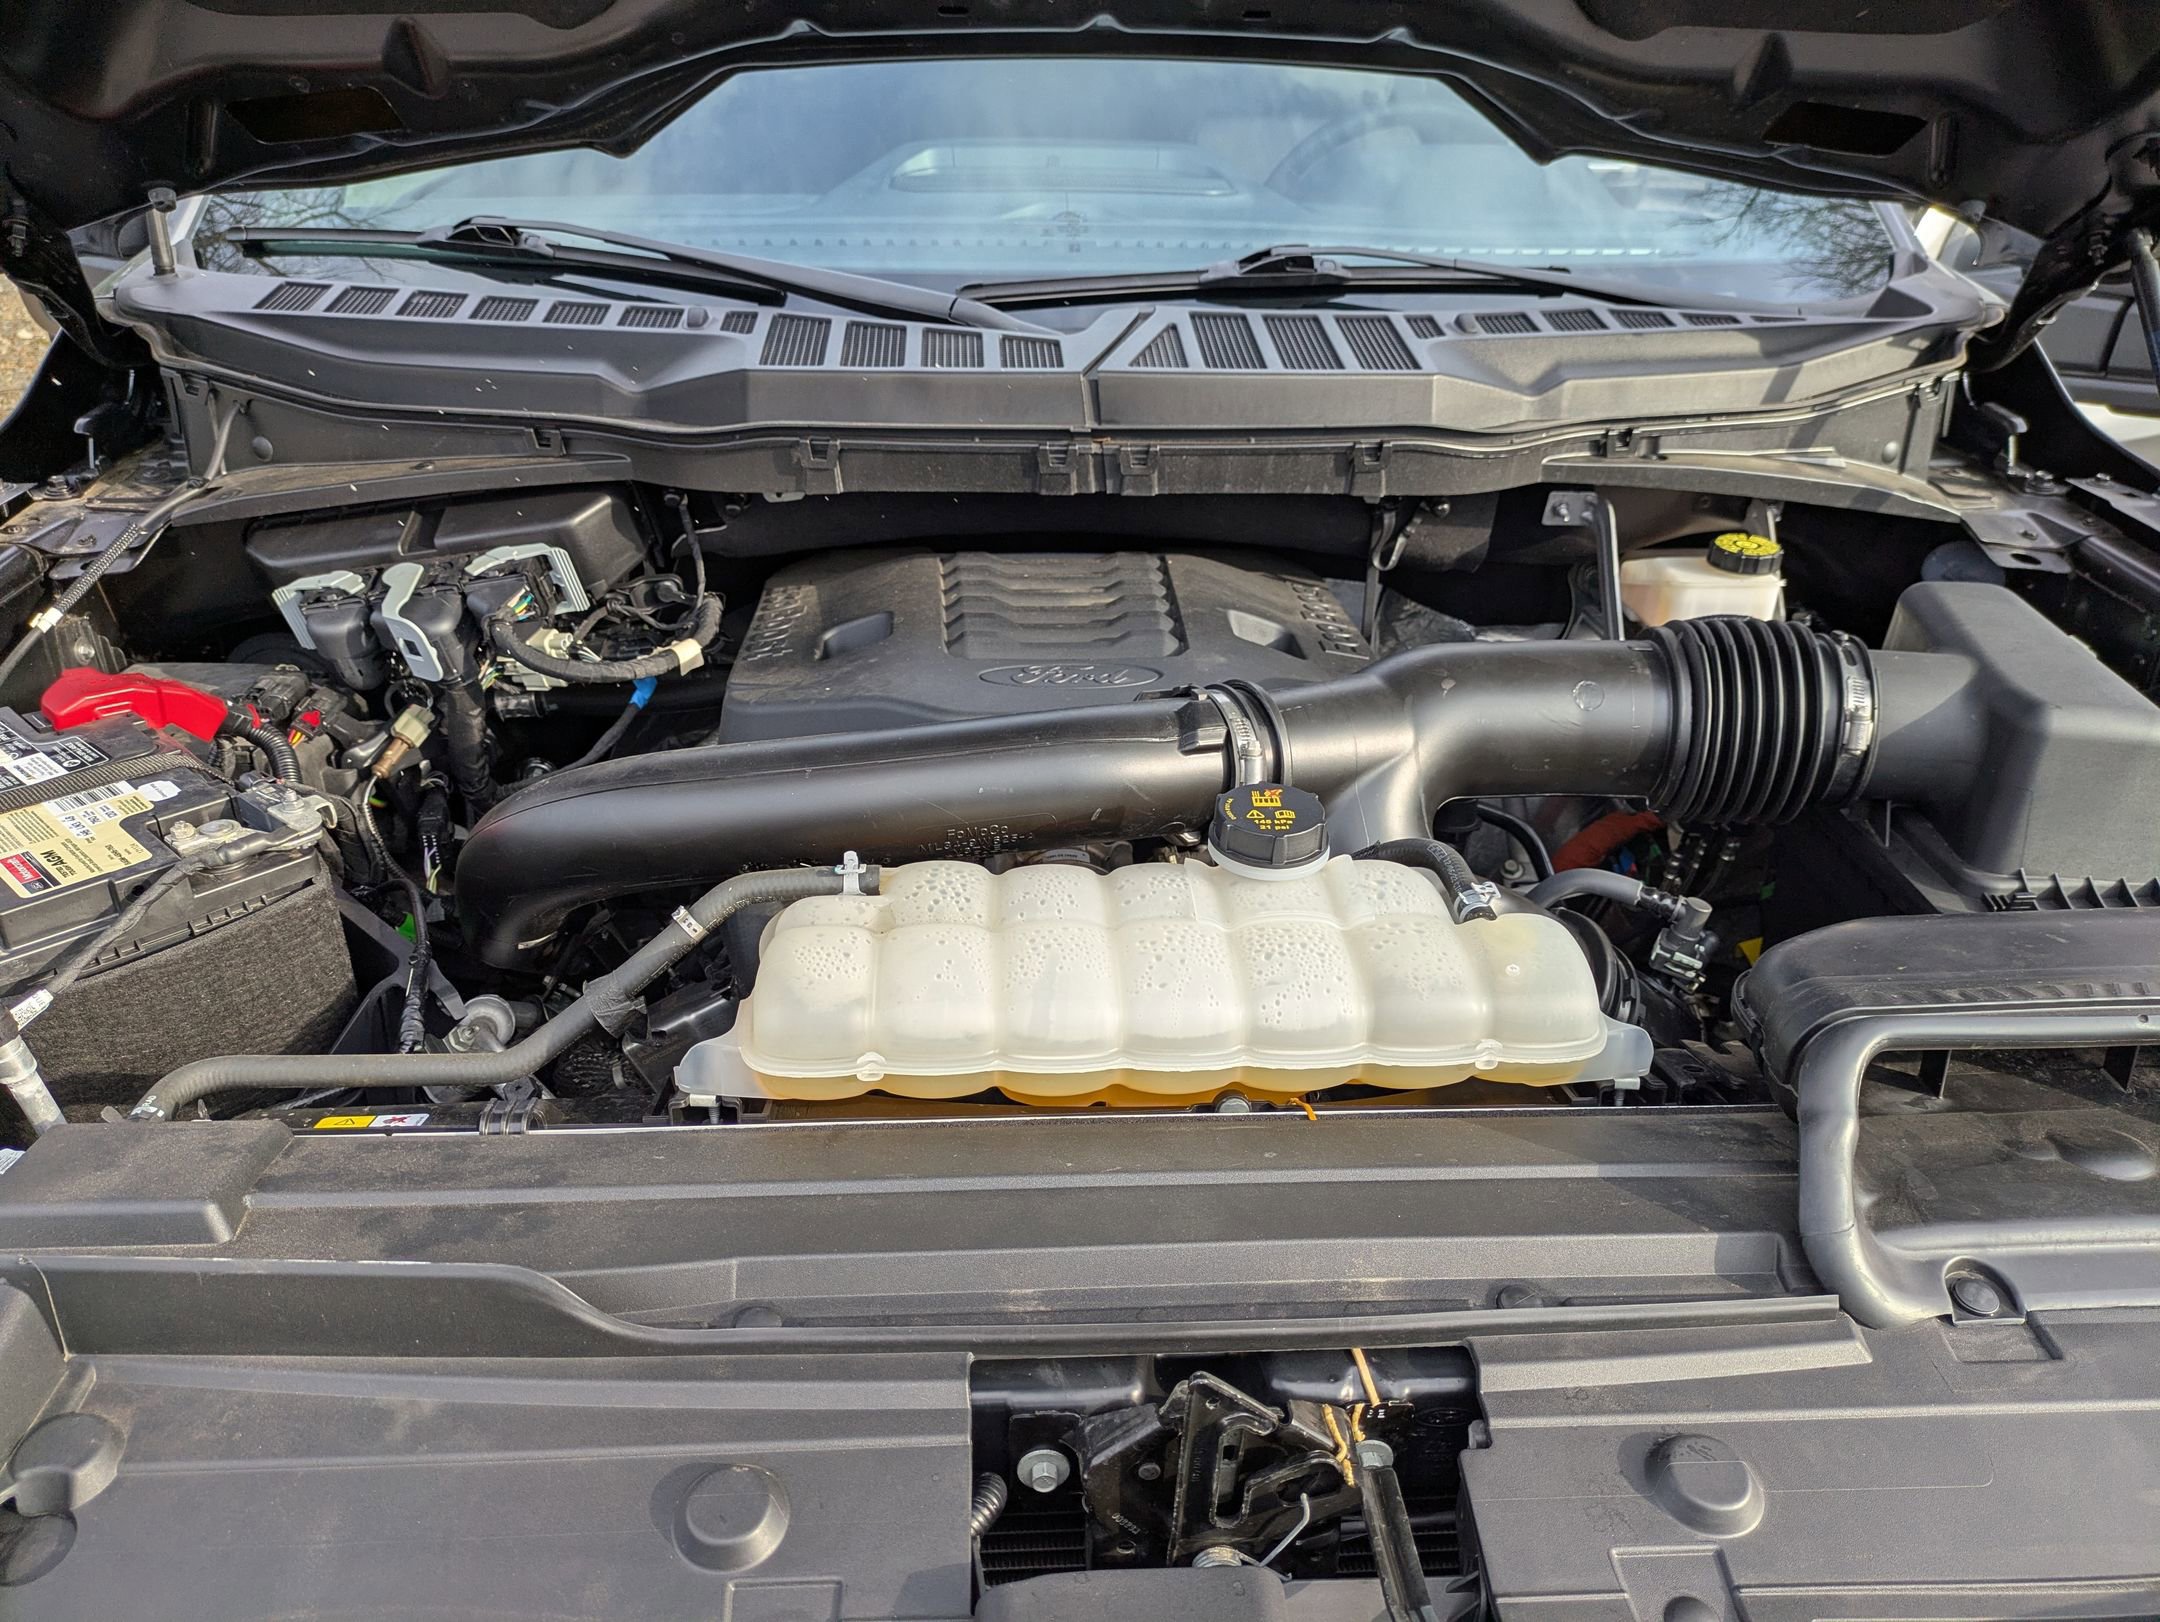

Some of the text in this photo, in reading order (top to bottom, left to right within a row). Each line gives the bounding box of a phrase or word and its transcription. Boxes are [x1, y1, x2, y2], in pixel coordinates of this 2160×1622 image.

[1010, 664, 1129, 684] Ford
[5, 857, 35, 879] Motorcraft
[39, 849, 67, 867] AGM
